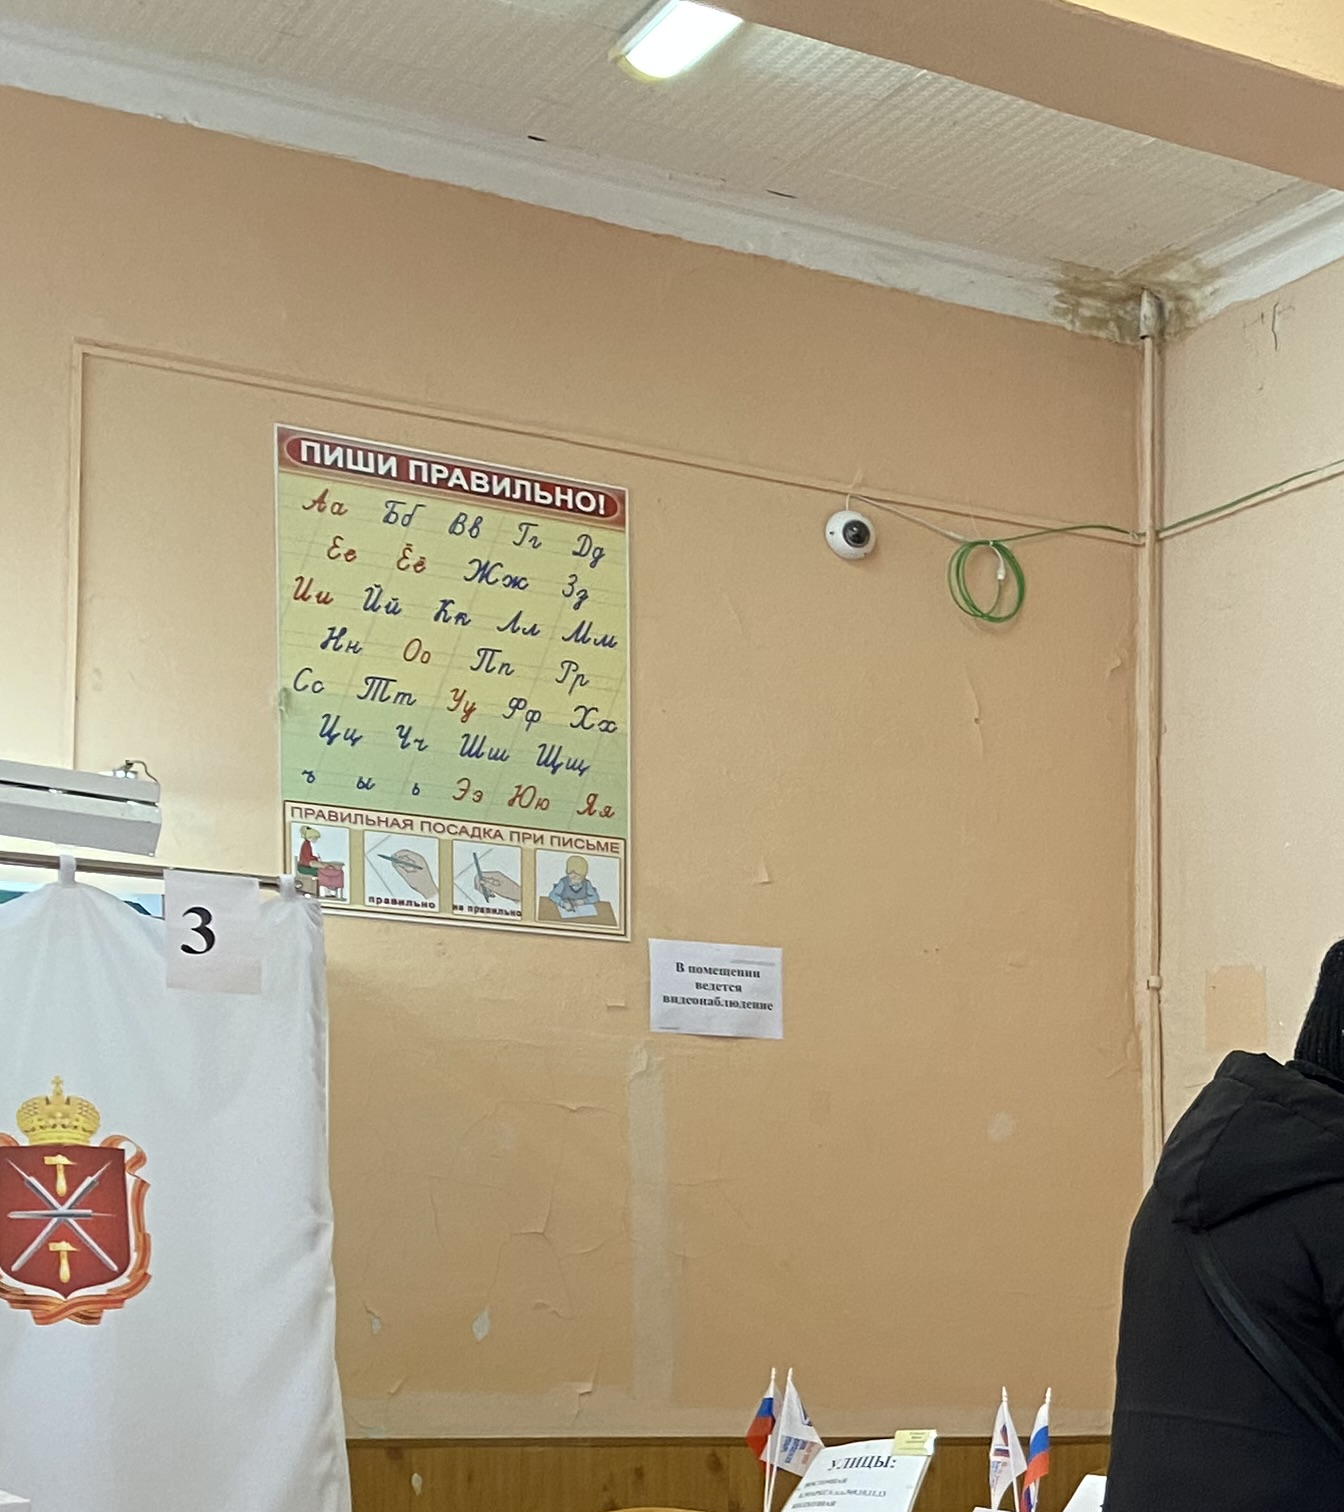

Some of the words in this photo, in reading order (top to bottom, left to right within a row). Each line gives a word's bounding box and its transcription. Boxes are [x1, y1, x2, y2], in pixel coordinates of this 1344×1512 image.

[300, 440, 397, 478] ПИШИ
[408, 460, 606, 516] ПРАВИЛЬНО!
[291, 806, 414, 831] ПРАВИЛЬНАЯ
[420, 820, 503, 841] ПОСАДКА
[509, 831, 544, 846] ПРИ
[550, 835, 621, 854] ПИСЬМЕ
[368, 895, 436, 909] правильно
[180, 906, 216, 955] 3
[675, 962, 685, 973] В
[688, 965, 761, 978] помещении
[695, 981, 742, 993] ведется
[662, 995, 774, 1011] видеонаблюдение
[827, 1455, 897, 1471] УЛИЦЫ:
